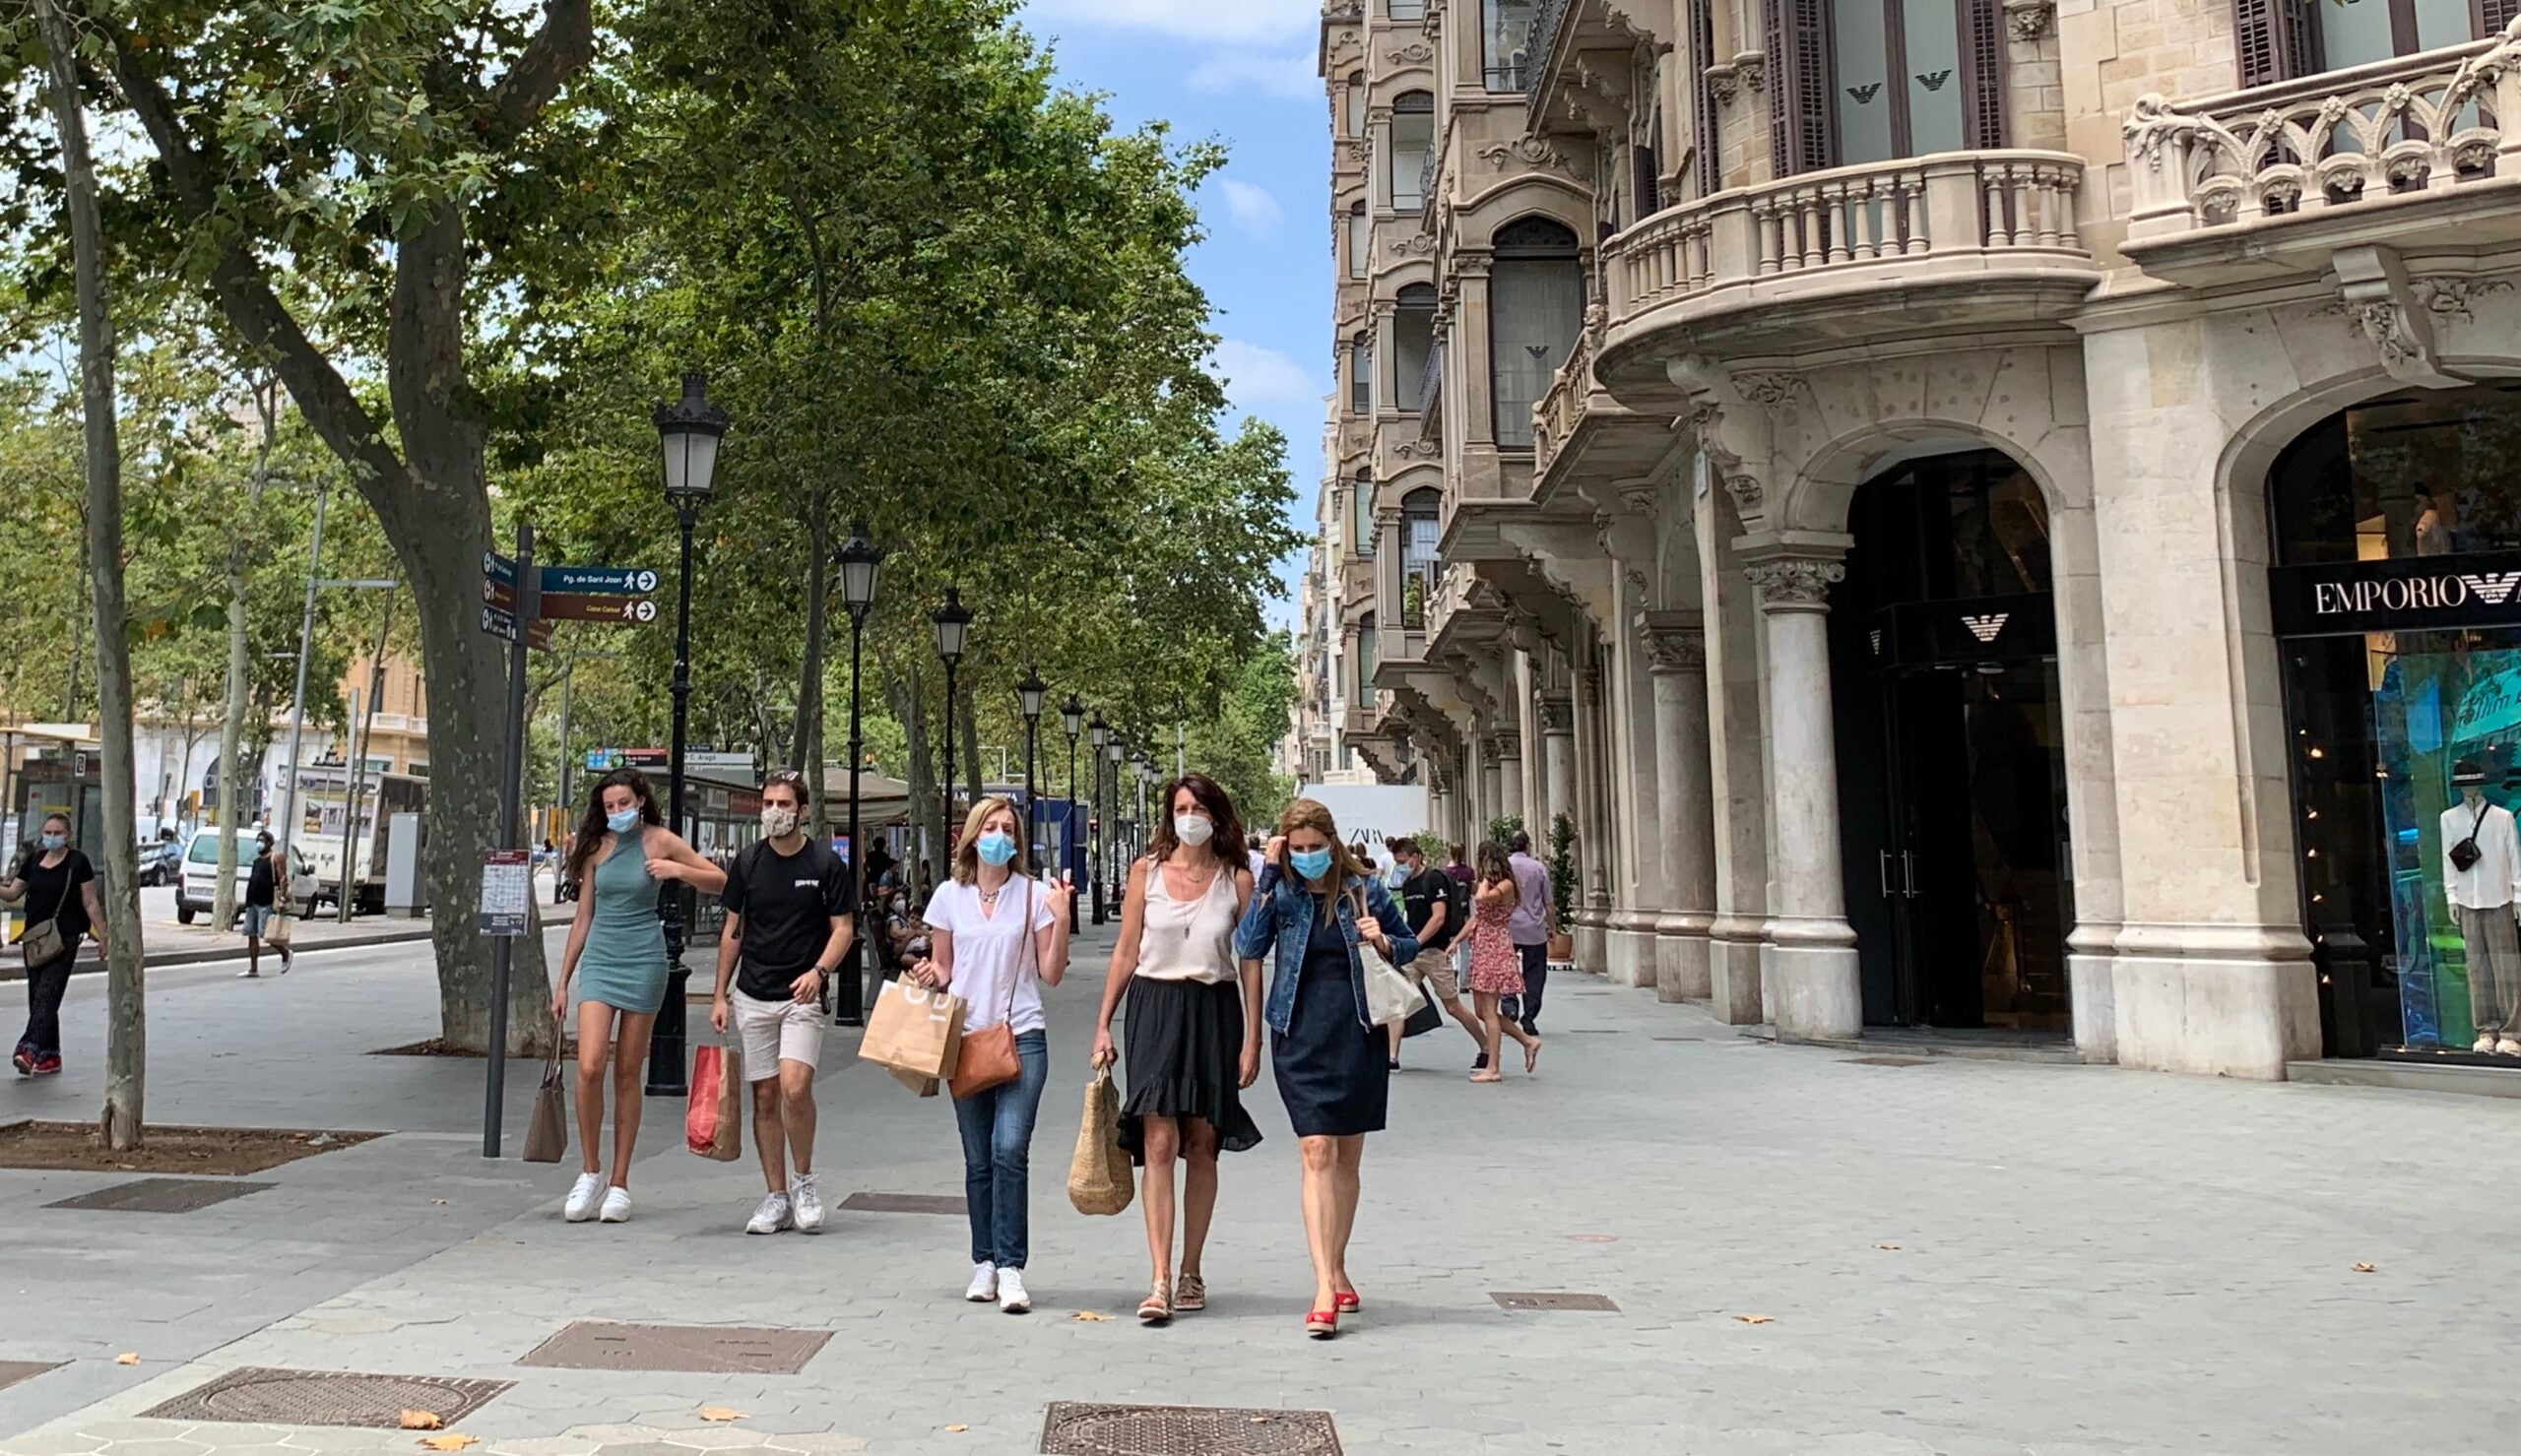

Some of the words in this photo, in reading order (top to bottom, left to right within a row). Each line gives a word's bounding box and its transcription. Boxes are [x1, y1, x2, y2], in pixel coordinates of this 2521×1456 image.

[563, 575, 575, 585] Pg.
[576, 575, 586, 584] de
[587, 575, 603, 584] Sant
[2315, 575, 2467, 614] EMPORIO
[1349, 827, 1385, 844] ZARA
